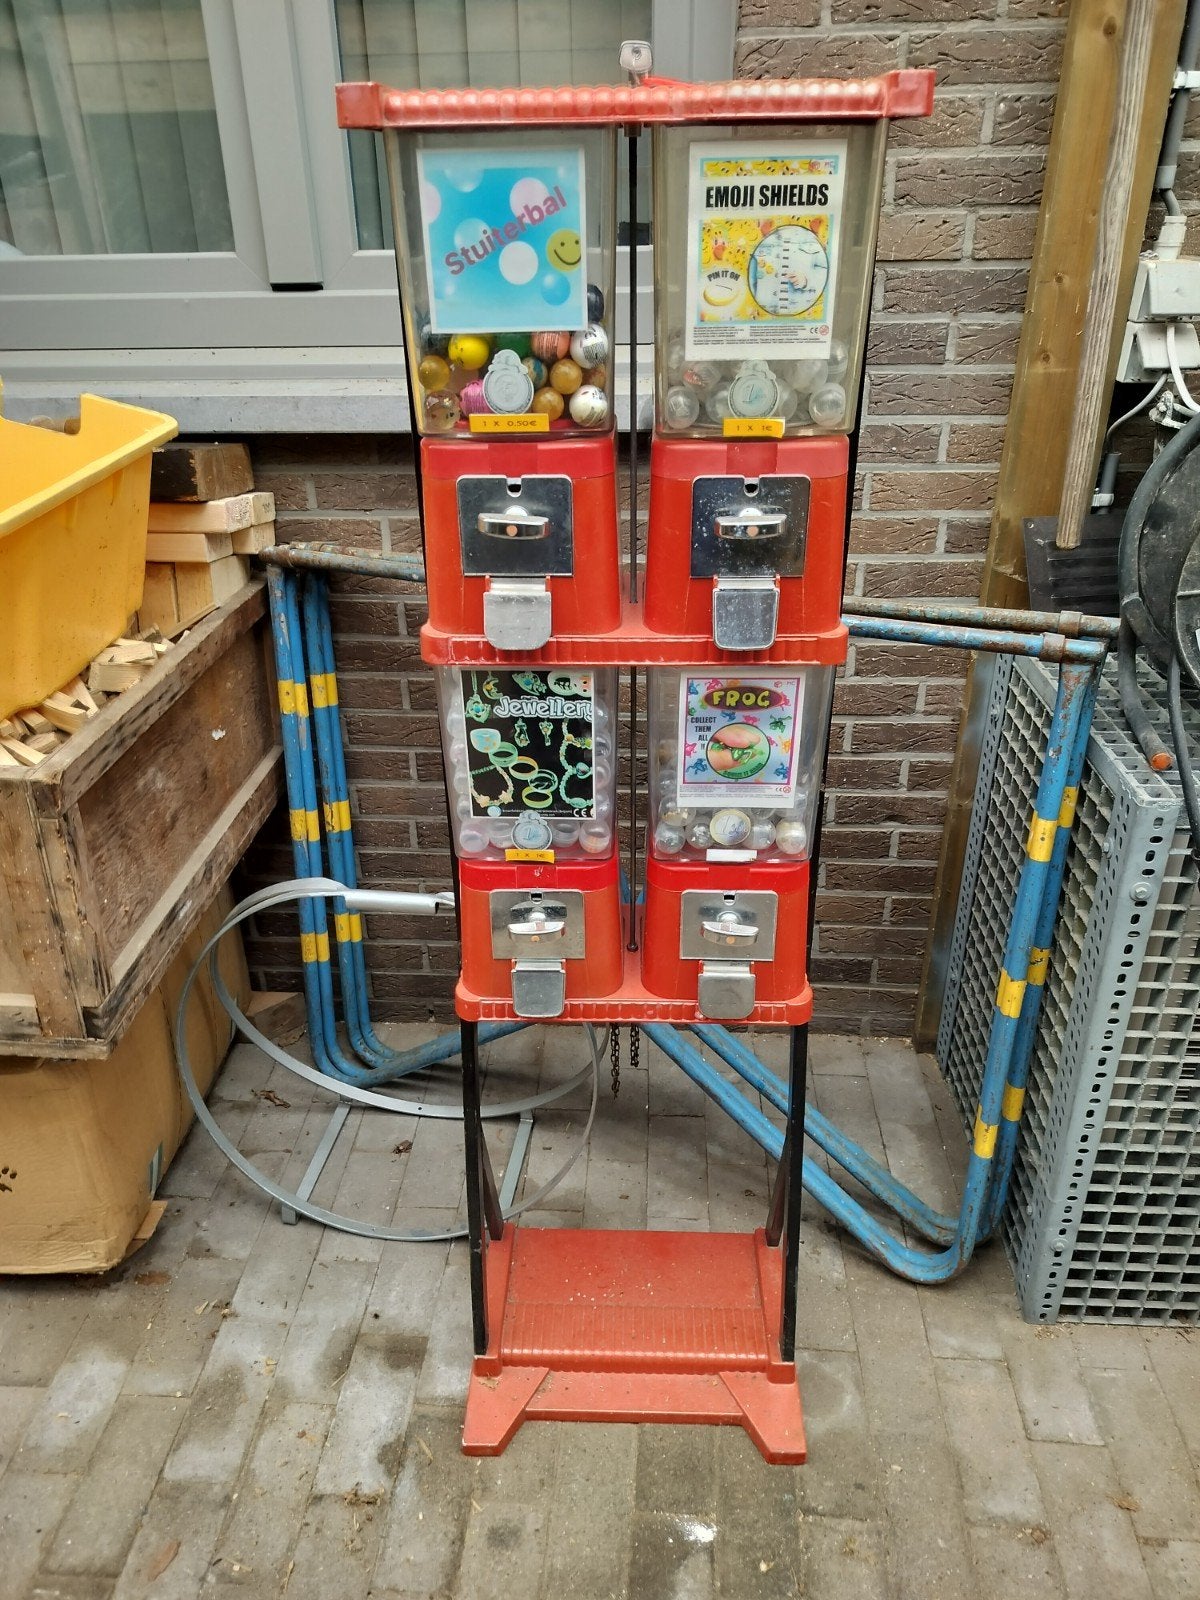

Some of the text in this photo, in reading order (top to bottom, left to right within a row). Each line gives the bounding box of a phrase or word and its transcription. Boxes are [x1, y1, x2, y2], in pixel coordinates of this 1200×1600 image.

[705, 183, 829, 208] EMOJI SHIELDS
[444, 185, 567, 275] Stuiterbal
[707, 270, 741, 282] PIN IT ON
[493, 696, 592, 722] Jewellery
[712, 690, 770, 708] FROG
[690, 716, 717, 724] COLLECT
